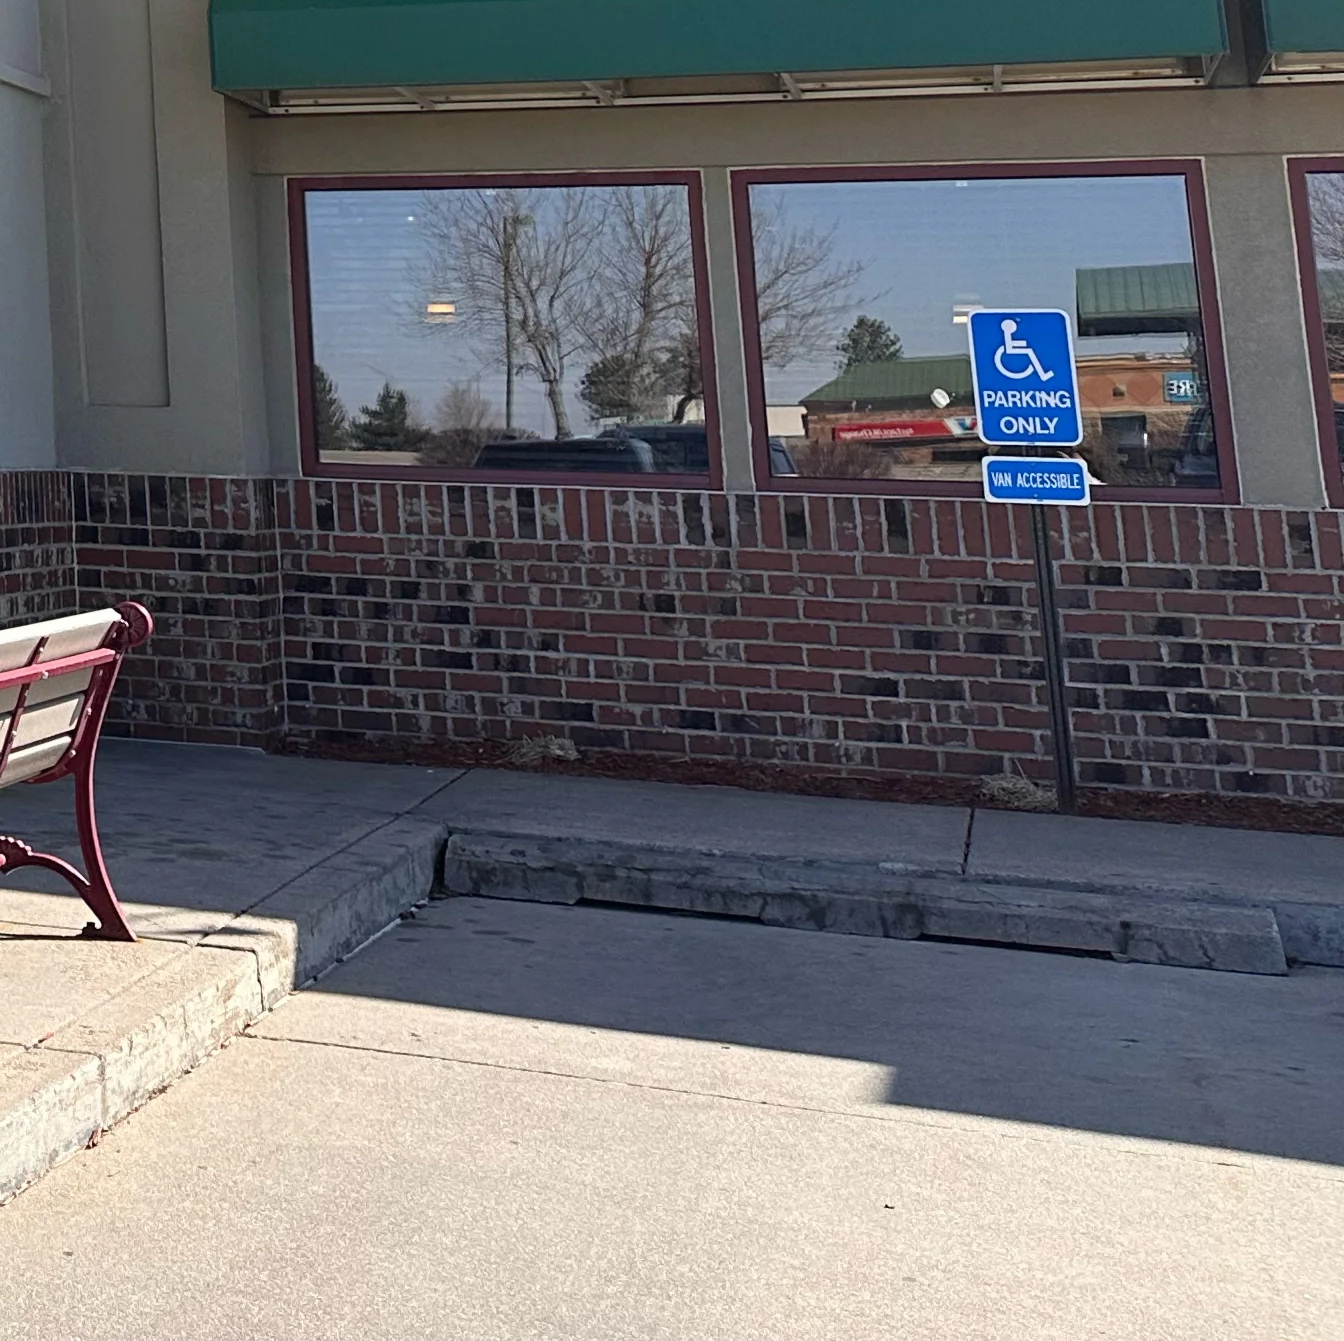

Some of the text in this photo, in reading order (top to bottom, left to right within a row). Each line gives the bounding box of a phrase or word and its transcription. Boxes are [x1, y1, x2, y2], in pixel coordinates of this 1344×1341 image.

[983, 390, 1072, 408] PARKING
[999, 416, 1059, 434] ONLY
[991, 472, 1081, 489] VAN ACCESSIBLE
